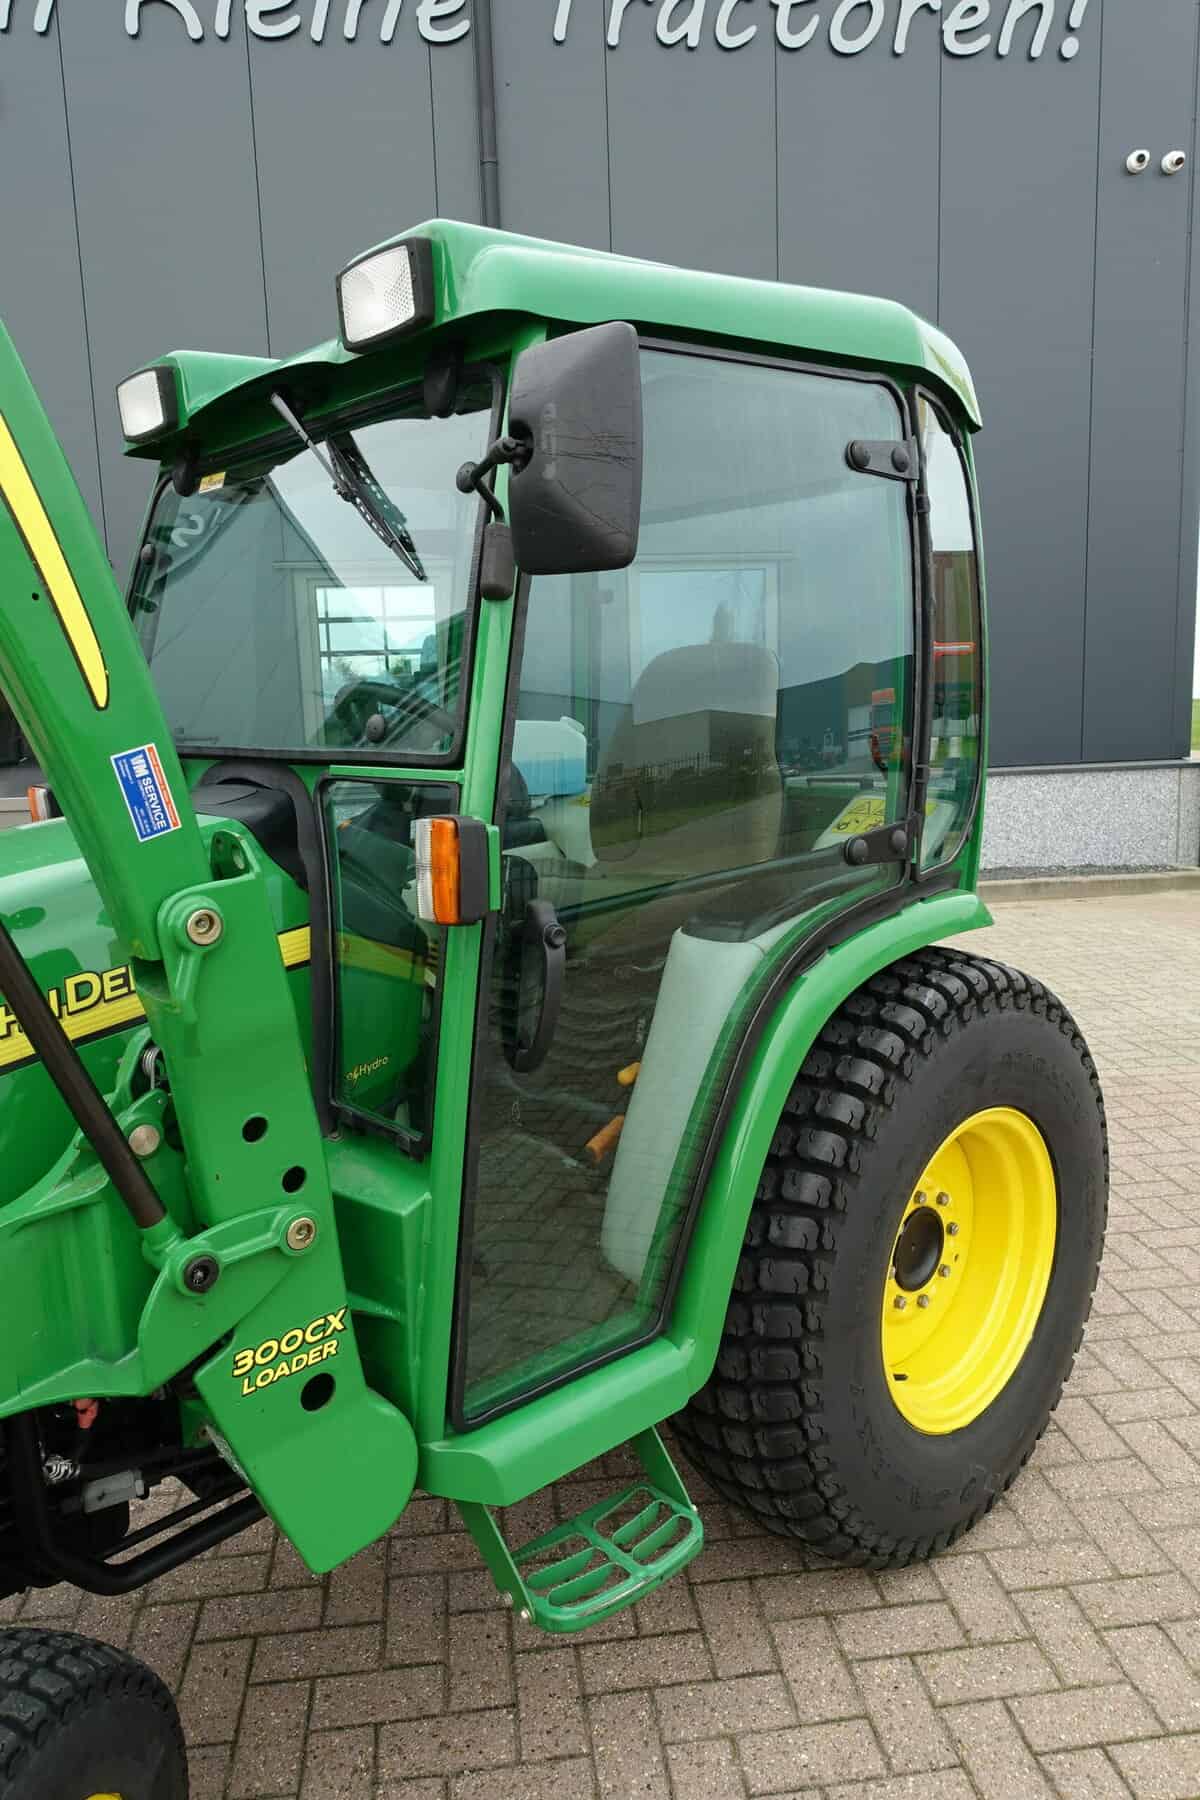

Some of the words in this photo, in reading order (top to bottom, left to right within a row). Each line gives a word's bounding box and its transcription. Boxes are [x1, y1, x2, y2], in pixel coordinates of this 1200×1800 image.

[142, 777, 167, 829] SERVICE
[232, 1306, 347, 1377] 300CX
[242, 1339, 338, 1396] LOADER
